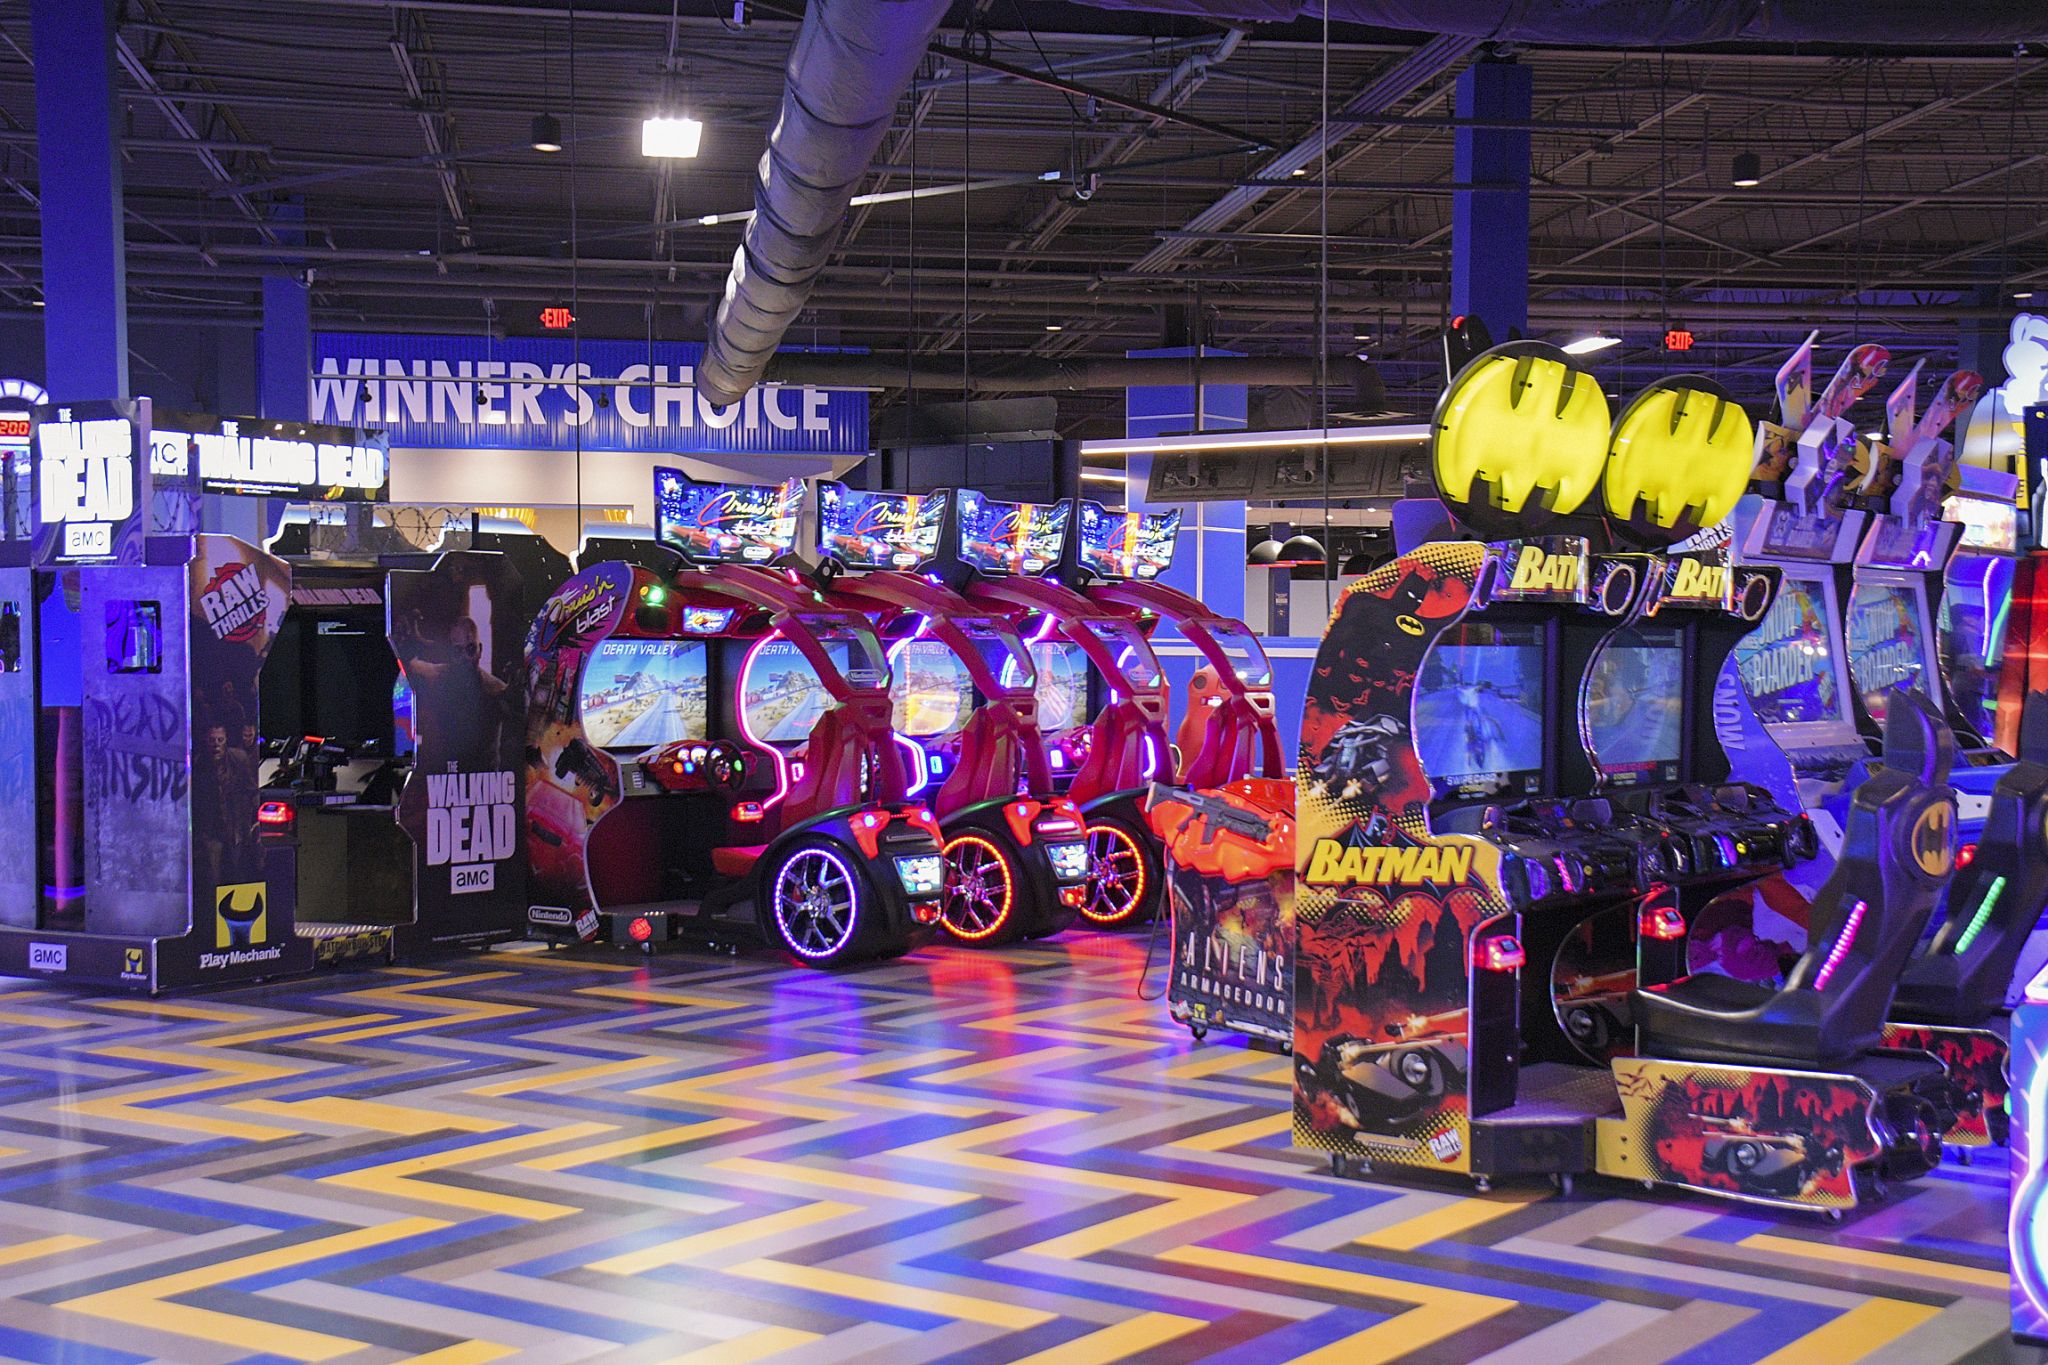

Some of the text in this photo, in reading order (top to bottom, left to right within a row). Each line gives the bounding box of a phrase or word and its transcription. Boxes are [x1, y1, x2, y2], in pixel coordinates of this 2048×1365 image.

[544, 308, 569, 328] EXIT
[1668, 331, 1691, 350] EXIT
[311, 358, 594, 426] WINNER'S
[318, 444, 384, 489] DEAD
[40, 456, 133, 523] DEAD
[200, 563, 262, 625] RAW
[211, 590, 270, 640] THRILLS
[576, 595, 615, 634] blast
[603, 645, 677, 655] DEATH VALLEY
[759, 645, 789, 655] DEATH
[1717, 673, 1746, 750] SNOW
[427, 771, 516, 808] WALKING
[427, 804, 516, 866] DEAD
[1305, 838, 1474, 886] BATMAN
[531, 909, 569, 921] Nintendo
[200, 946, 281, 969] Play Mechanix
[1186, 931, 1284, 992] ALIENS
[1180, 971, 1286, 1015] ARMAGEDDON
